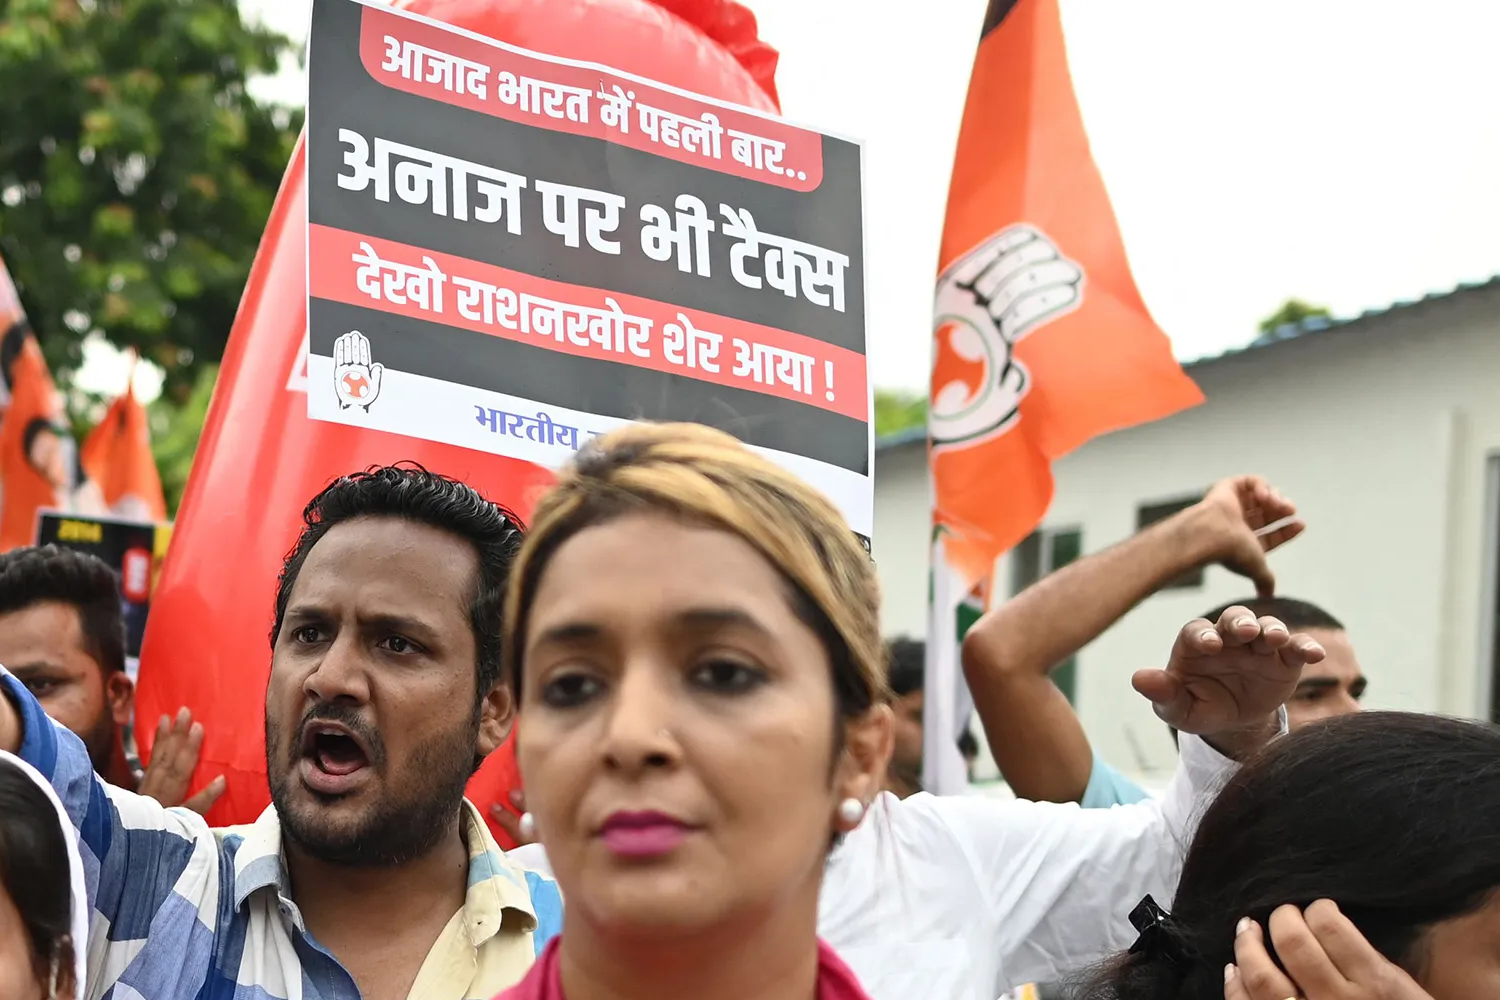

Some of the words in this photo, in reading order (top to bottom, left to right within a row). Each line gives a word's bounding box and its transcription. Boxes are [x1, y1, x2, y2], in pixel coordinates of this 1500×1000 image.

[381, 35, 491, 101] आजाद
[497, 70, 593, 124] भारत
[593, 82, 634, 134] में
[635, 102, 724, 160] पहली
[727, 128, 807, 182] बार..
[336, 128, 528, 236] अनाज
[534, 179, 627, 256] पर
[639, 193, 716, 279] भी
[718, 202, 850, 313] टैक्स
[351, 241, 448, 314] देखो
[451, 275, 655, 358] राशनखोर
[662, 312, 725, 375] शेर
[732, 337, 816, 396] आया
[474, 404, 580, 452] भारतीय
